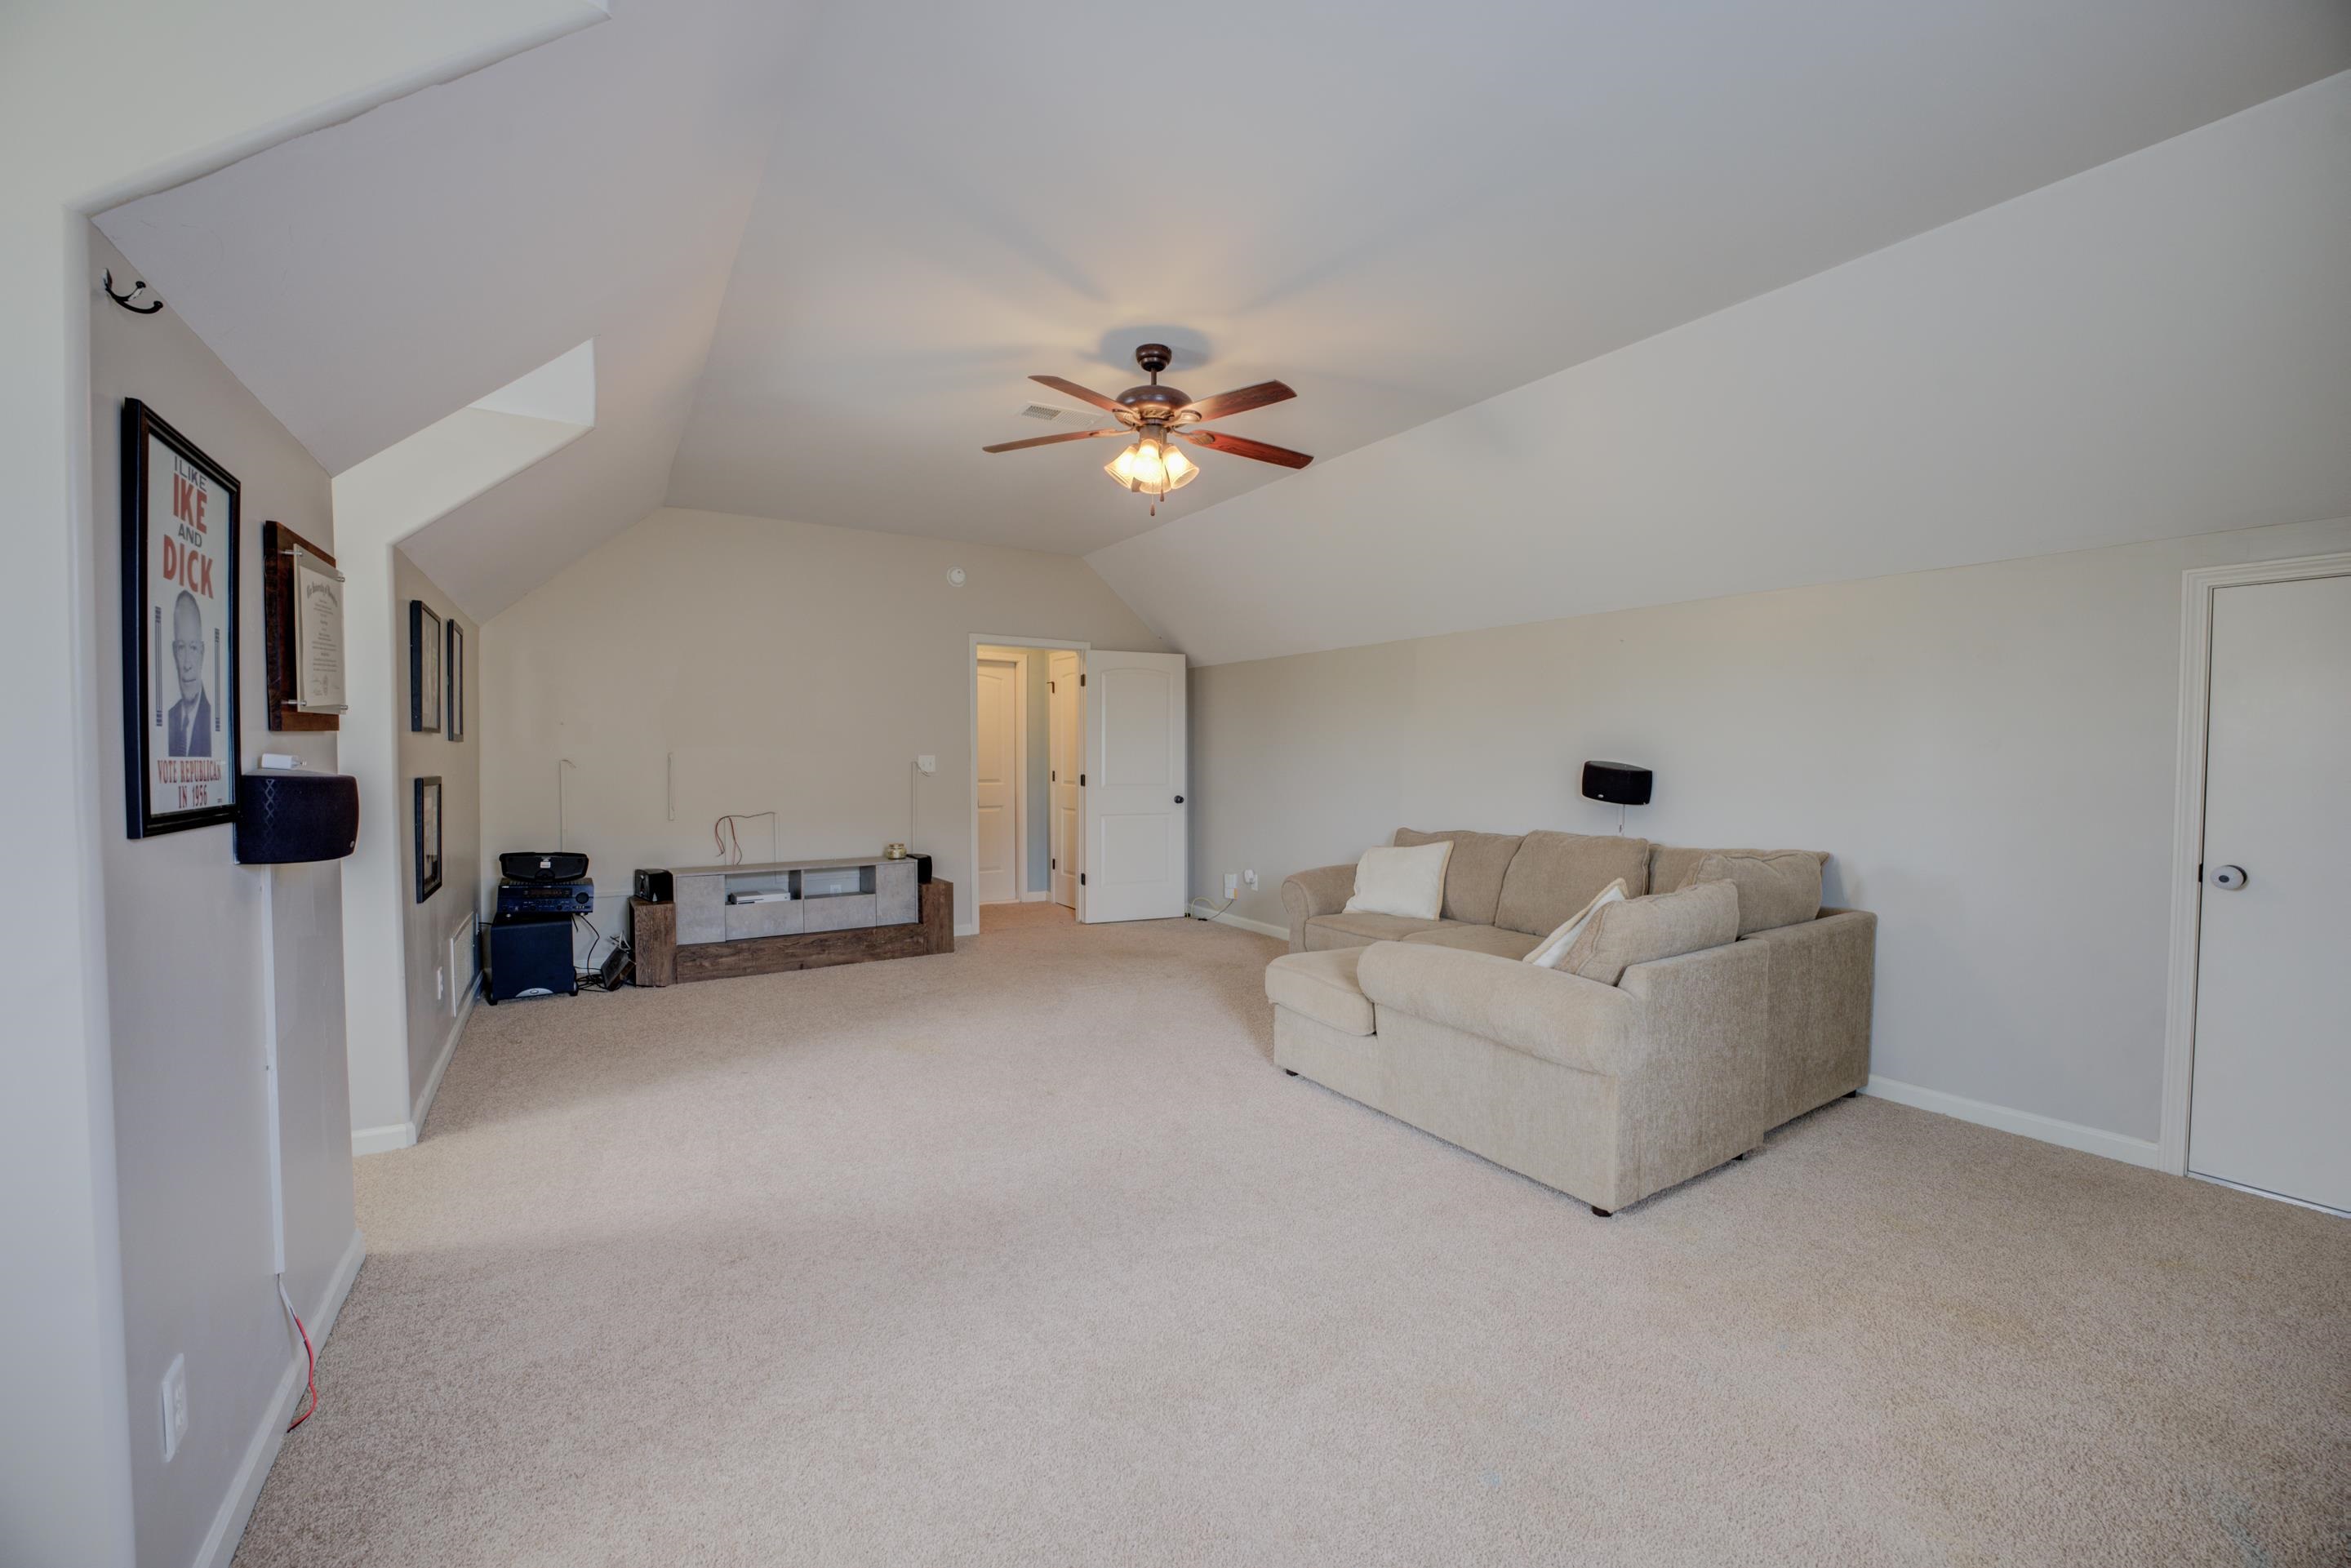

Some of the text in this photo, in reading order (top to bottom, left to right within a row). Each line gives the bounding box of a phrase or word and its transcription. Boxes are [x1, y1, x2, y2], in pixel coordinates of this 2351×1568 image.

[179, 460, 207, 492] LIKE
[173, 473, 207, 535] IKE
[178, 523, 202, 548] AND
[163, 534, 214, 599] DICK
[158, 759, 221, 784] VOTE REPUBLICAN
[178, 784, 207, 808] IN 1956
